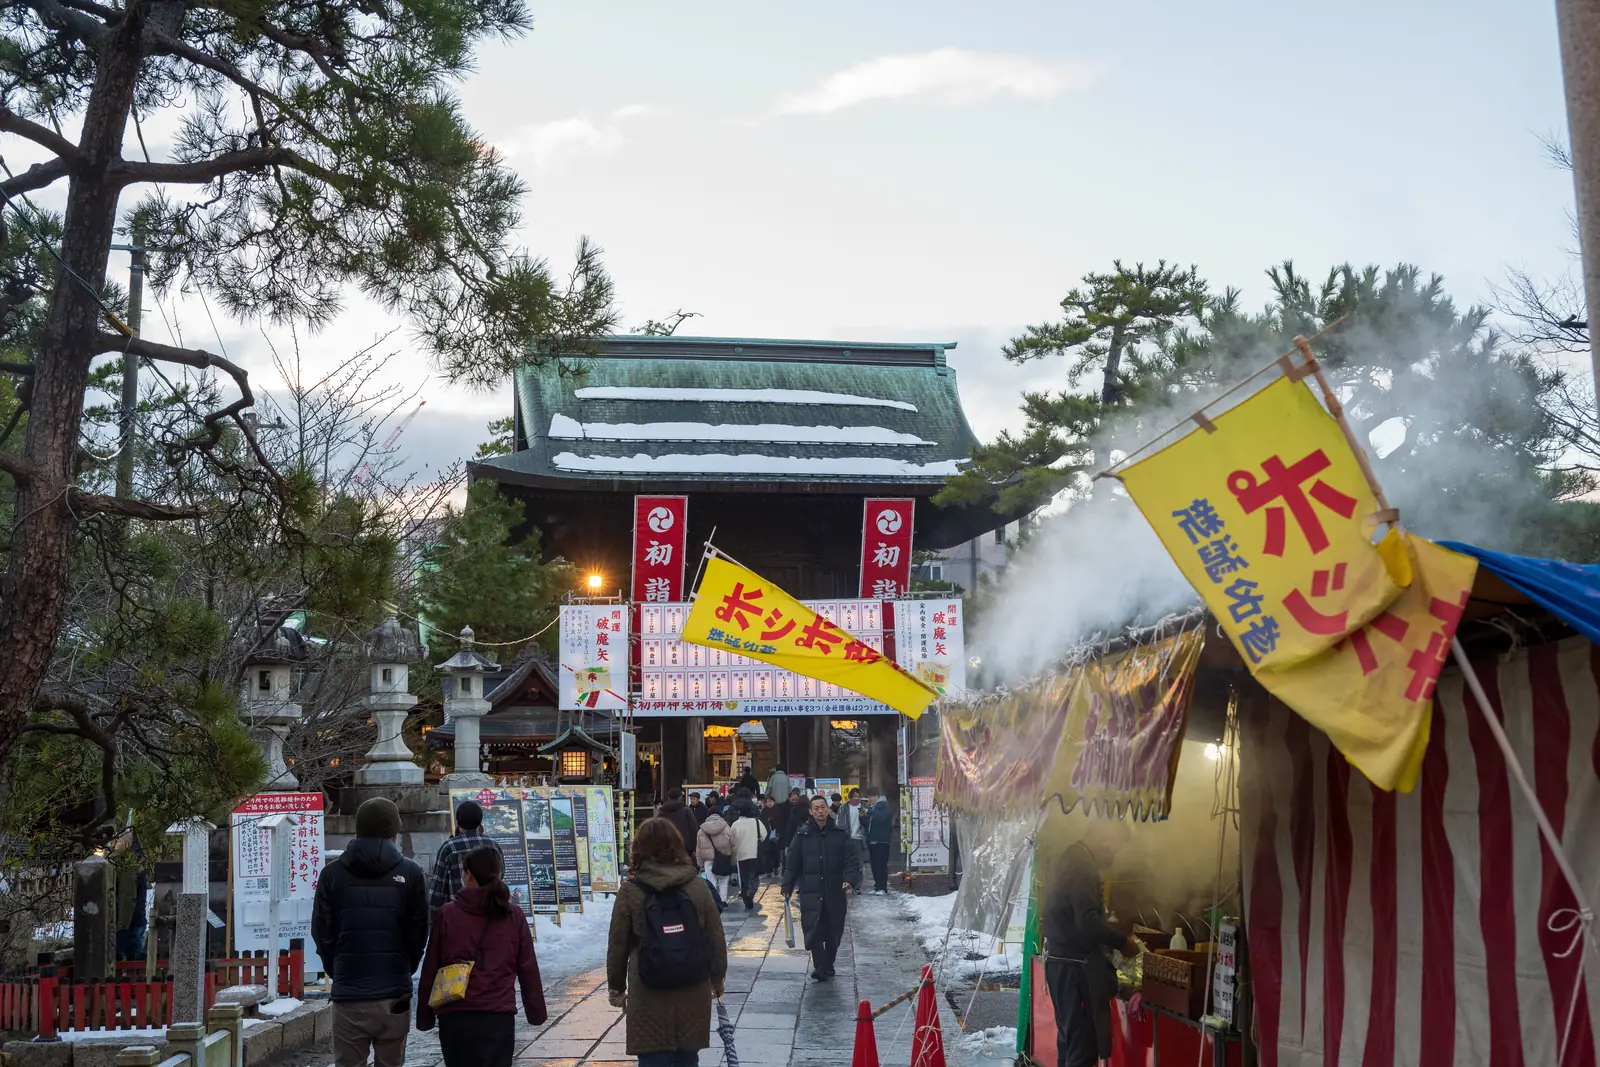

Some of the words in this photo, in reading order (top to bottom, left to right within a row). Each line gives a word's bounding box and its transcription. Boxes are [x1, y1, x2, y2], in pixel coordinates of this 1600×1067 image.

[643, 540, 674, 603] 初詣
[871, 541, 901, 603] 初詣
[611, 610, 620, 632] 開運
[932, 611, 947, 655] 破魔矢
[947, 604, 957, 626] 開運
[595, 616, 609, 661] 破魔矢
[297, 813, 309, 882] 事前に決めて
